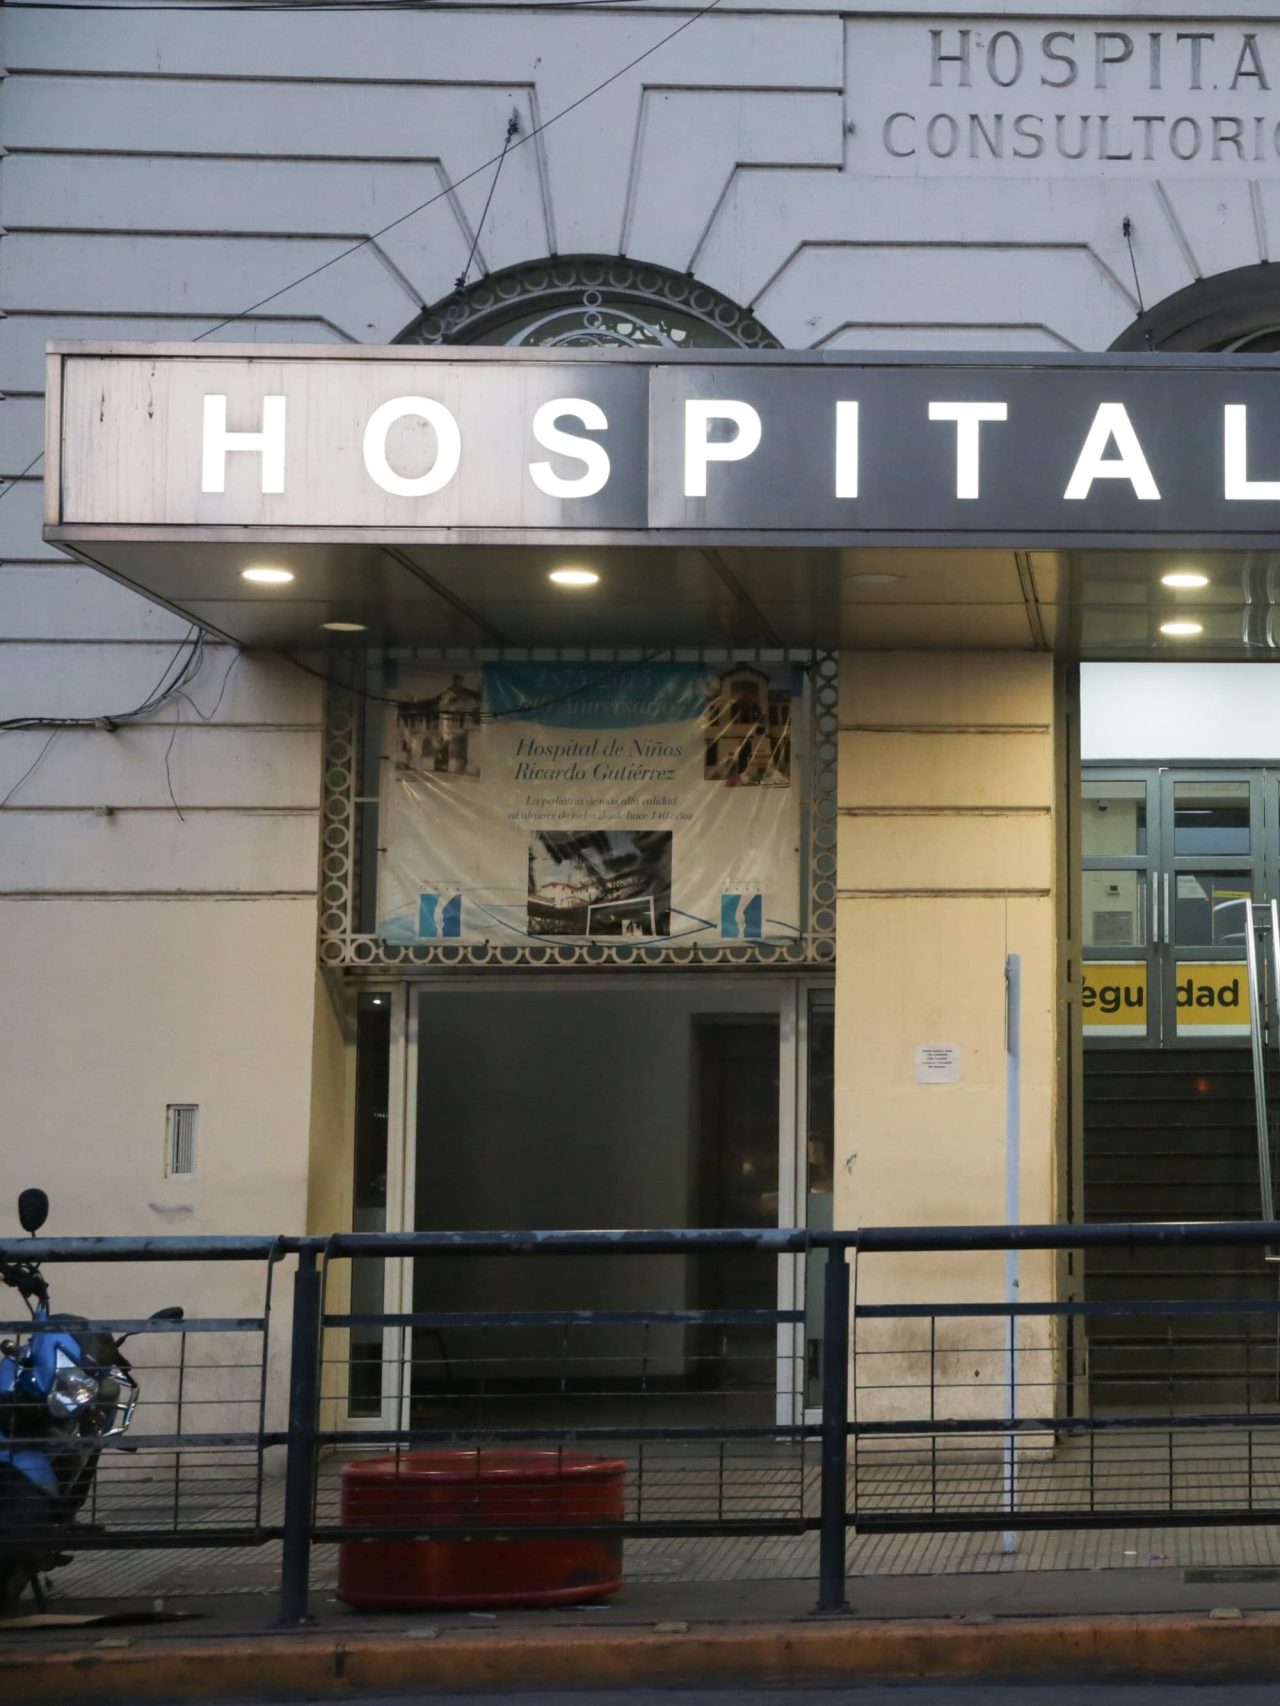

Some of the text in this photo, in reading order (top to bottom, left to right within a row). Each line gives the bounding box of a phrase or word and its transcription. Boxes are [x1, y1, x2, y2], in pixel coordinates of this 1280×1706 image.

[515, 738, 684, 762] Hospital de Niños
[514, 762, 676, 782] Ricardo Gutiérrez
[1081, 978, 1240, 1013] egudad
